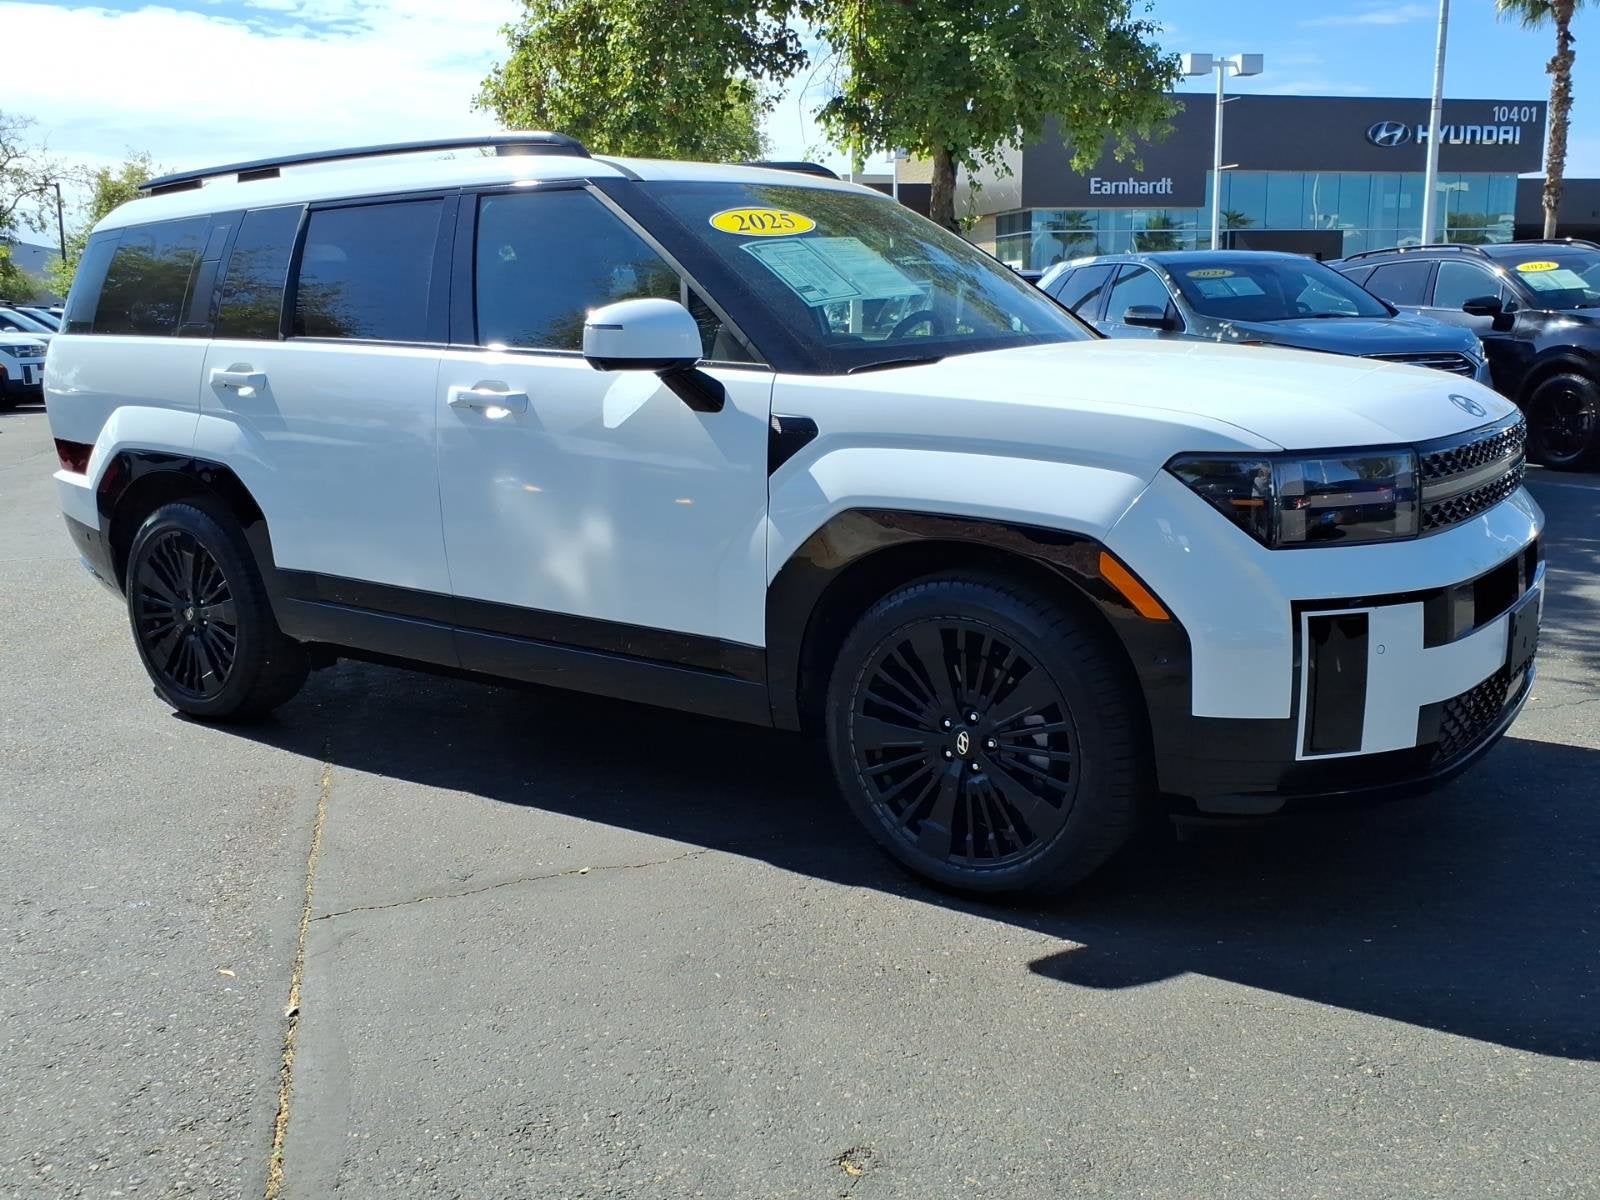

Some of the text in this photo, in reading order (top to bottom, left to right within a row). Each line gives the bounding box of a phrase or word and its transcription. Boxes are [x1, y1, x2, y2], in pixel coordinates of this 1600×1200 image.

[1492, 106, 1537, 122] 10401
[1417, 124, 1520, 145] HYUNDAI
[1089, 177, 1173, 194] Earnhardt
[731, 214, 796, 231] 2025
